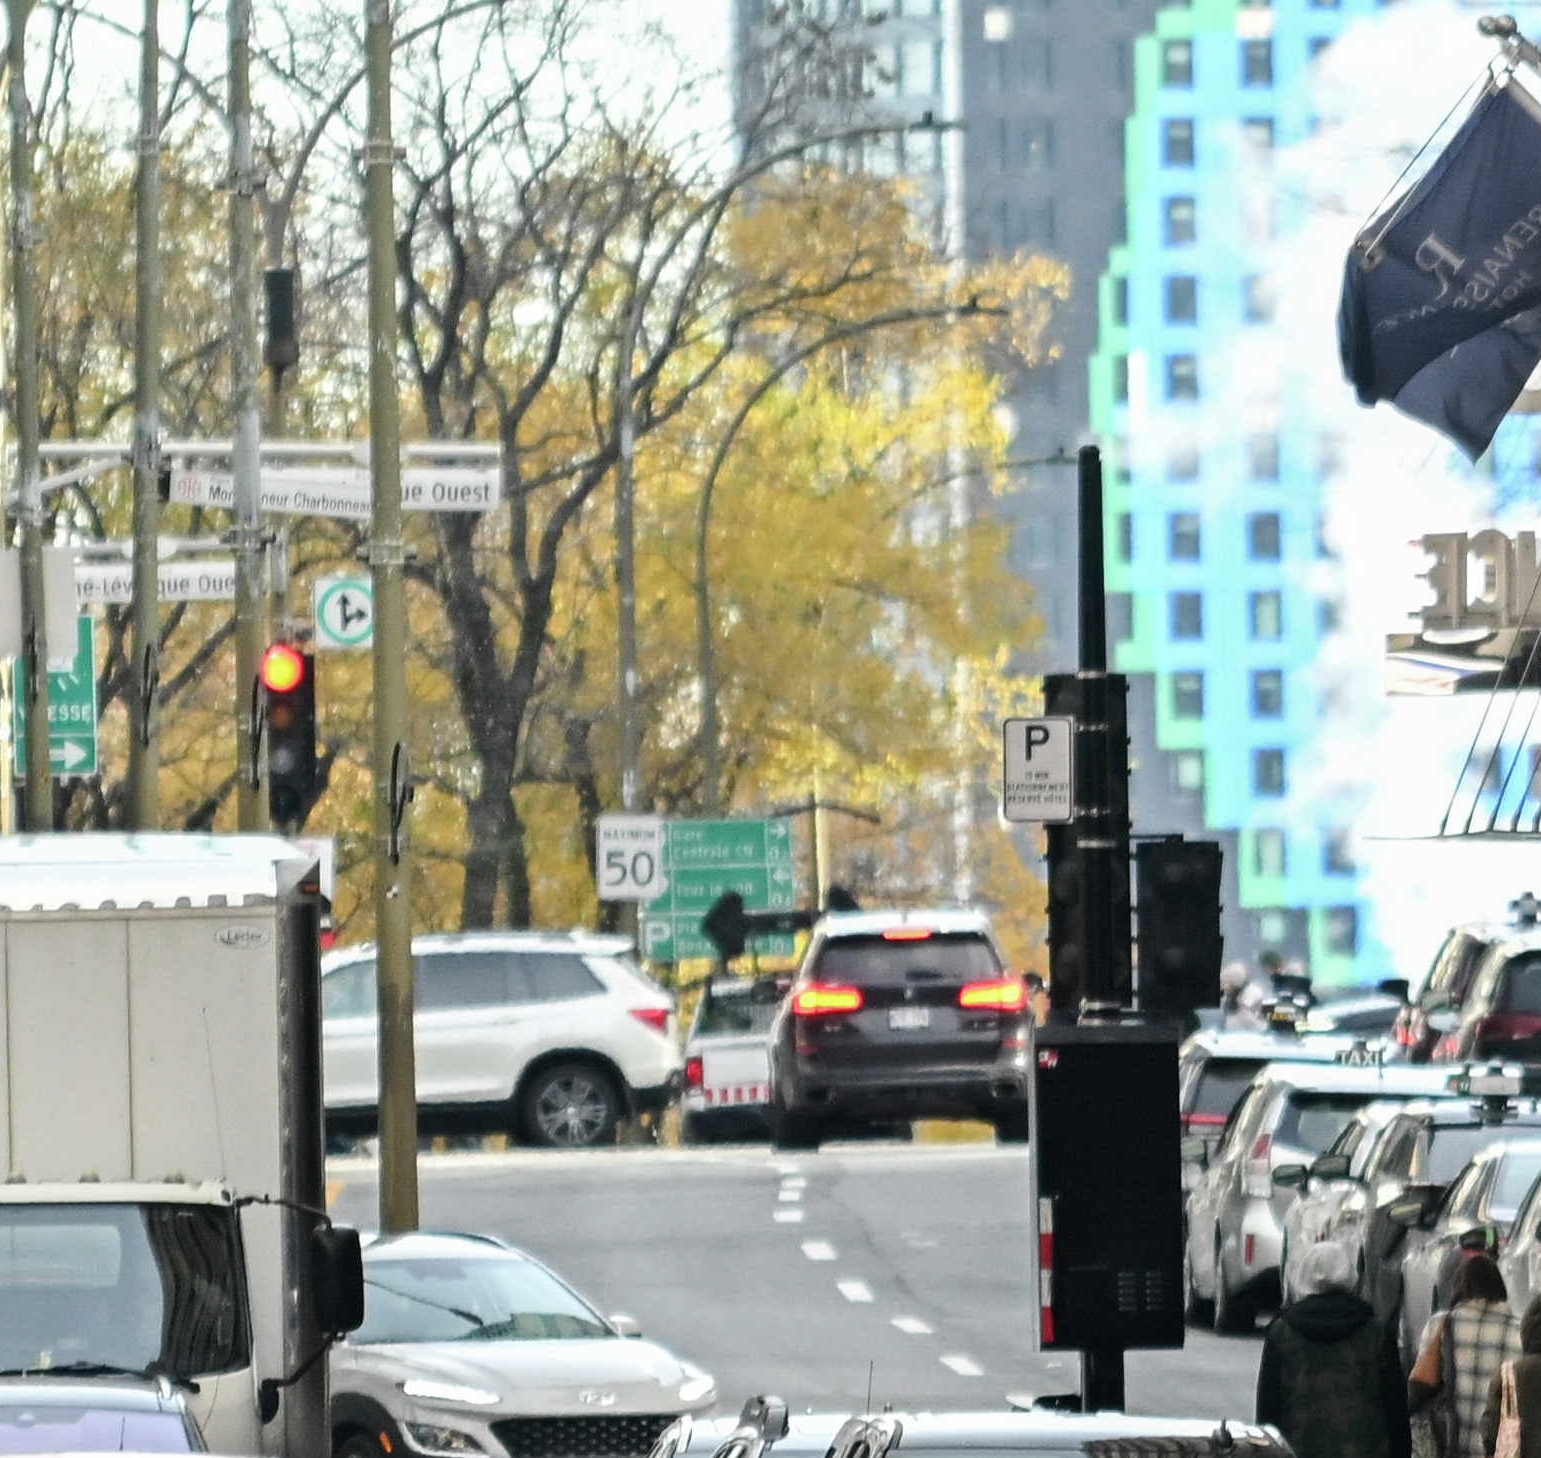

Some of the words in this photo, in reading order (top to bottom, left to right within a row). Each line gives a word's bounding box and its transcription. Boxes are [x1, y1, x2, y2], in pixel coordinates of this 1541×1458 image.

[432, 481, 490, 503] Ouest
[1025, 726, 1050, 761] P
[605, 851, 654, 886] 50
[1340, 1050, 1380, 1066] TAXI
